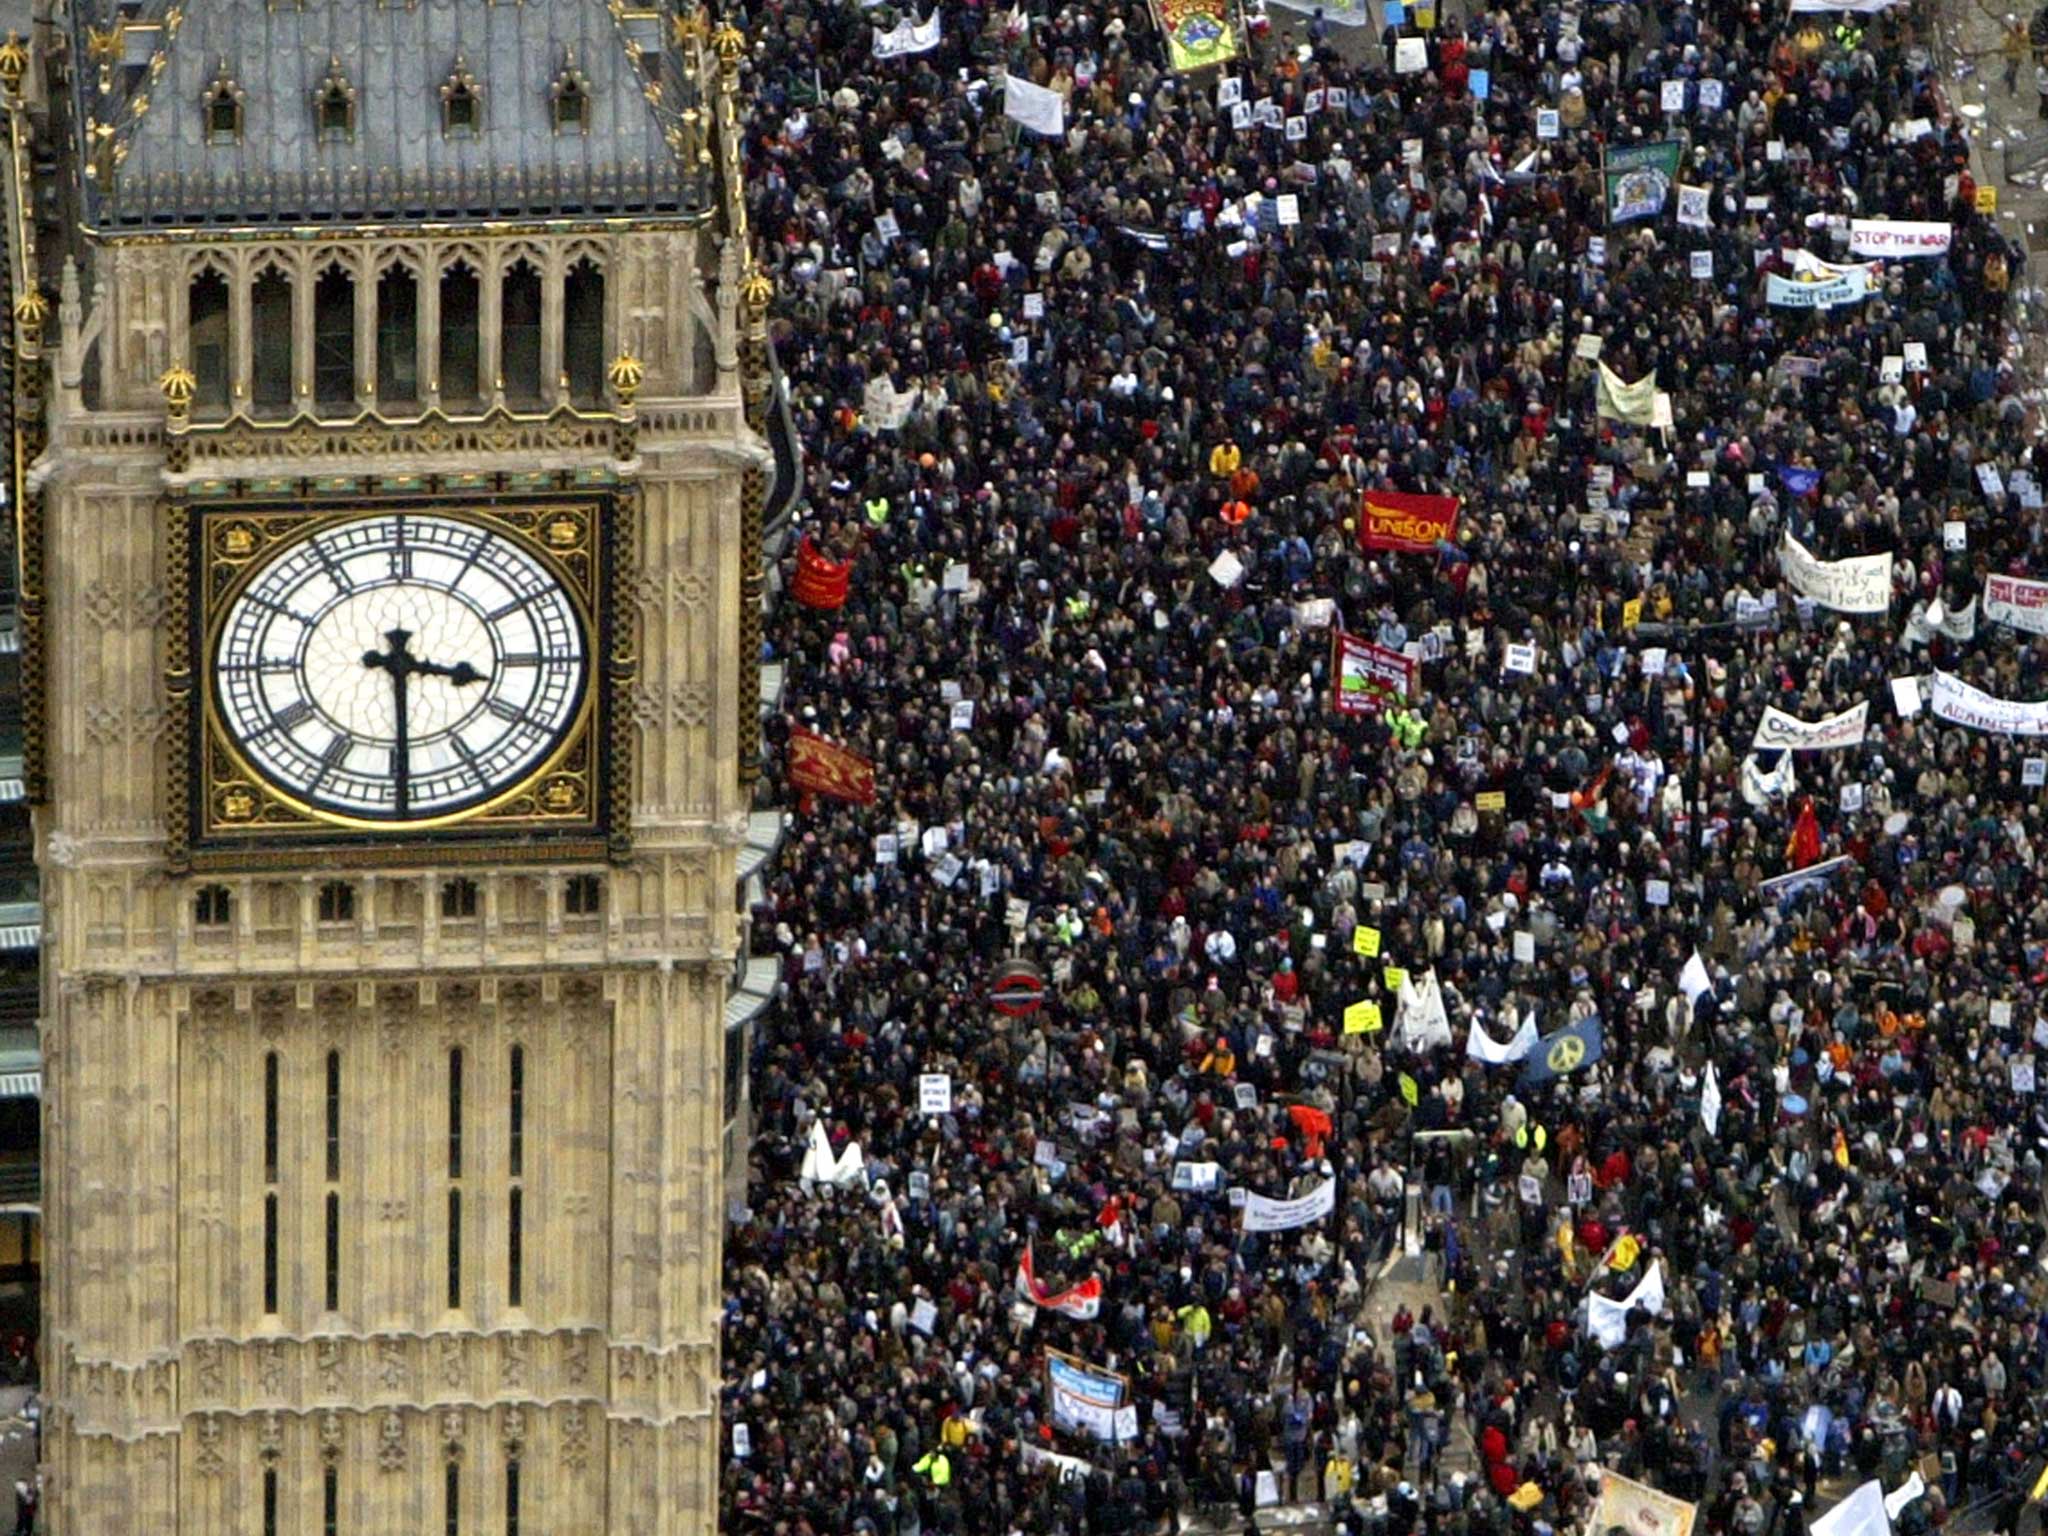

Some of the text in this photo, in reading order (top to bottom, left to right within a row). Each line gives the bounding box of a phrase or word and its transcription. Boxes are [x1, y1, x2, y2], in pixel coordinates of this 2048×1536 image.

[1854, 230, 1892, 245] STOP
[1894, 233, 1916, 245] THE
[1369, 516, 1447, 542] UNISON
[1942, 701, 2024, 732] AGAINST
